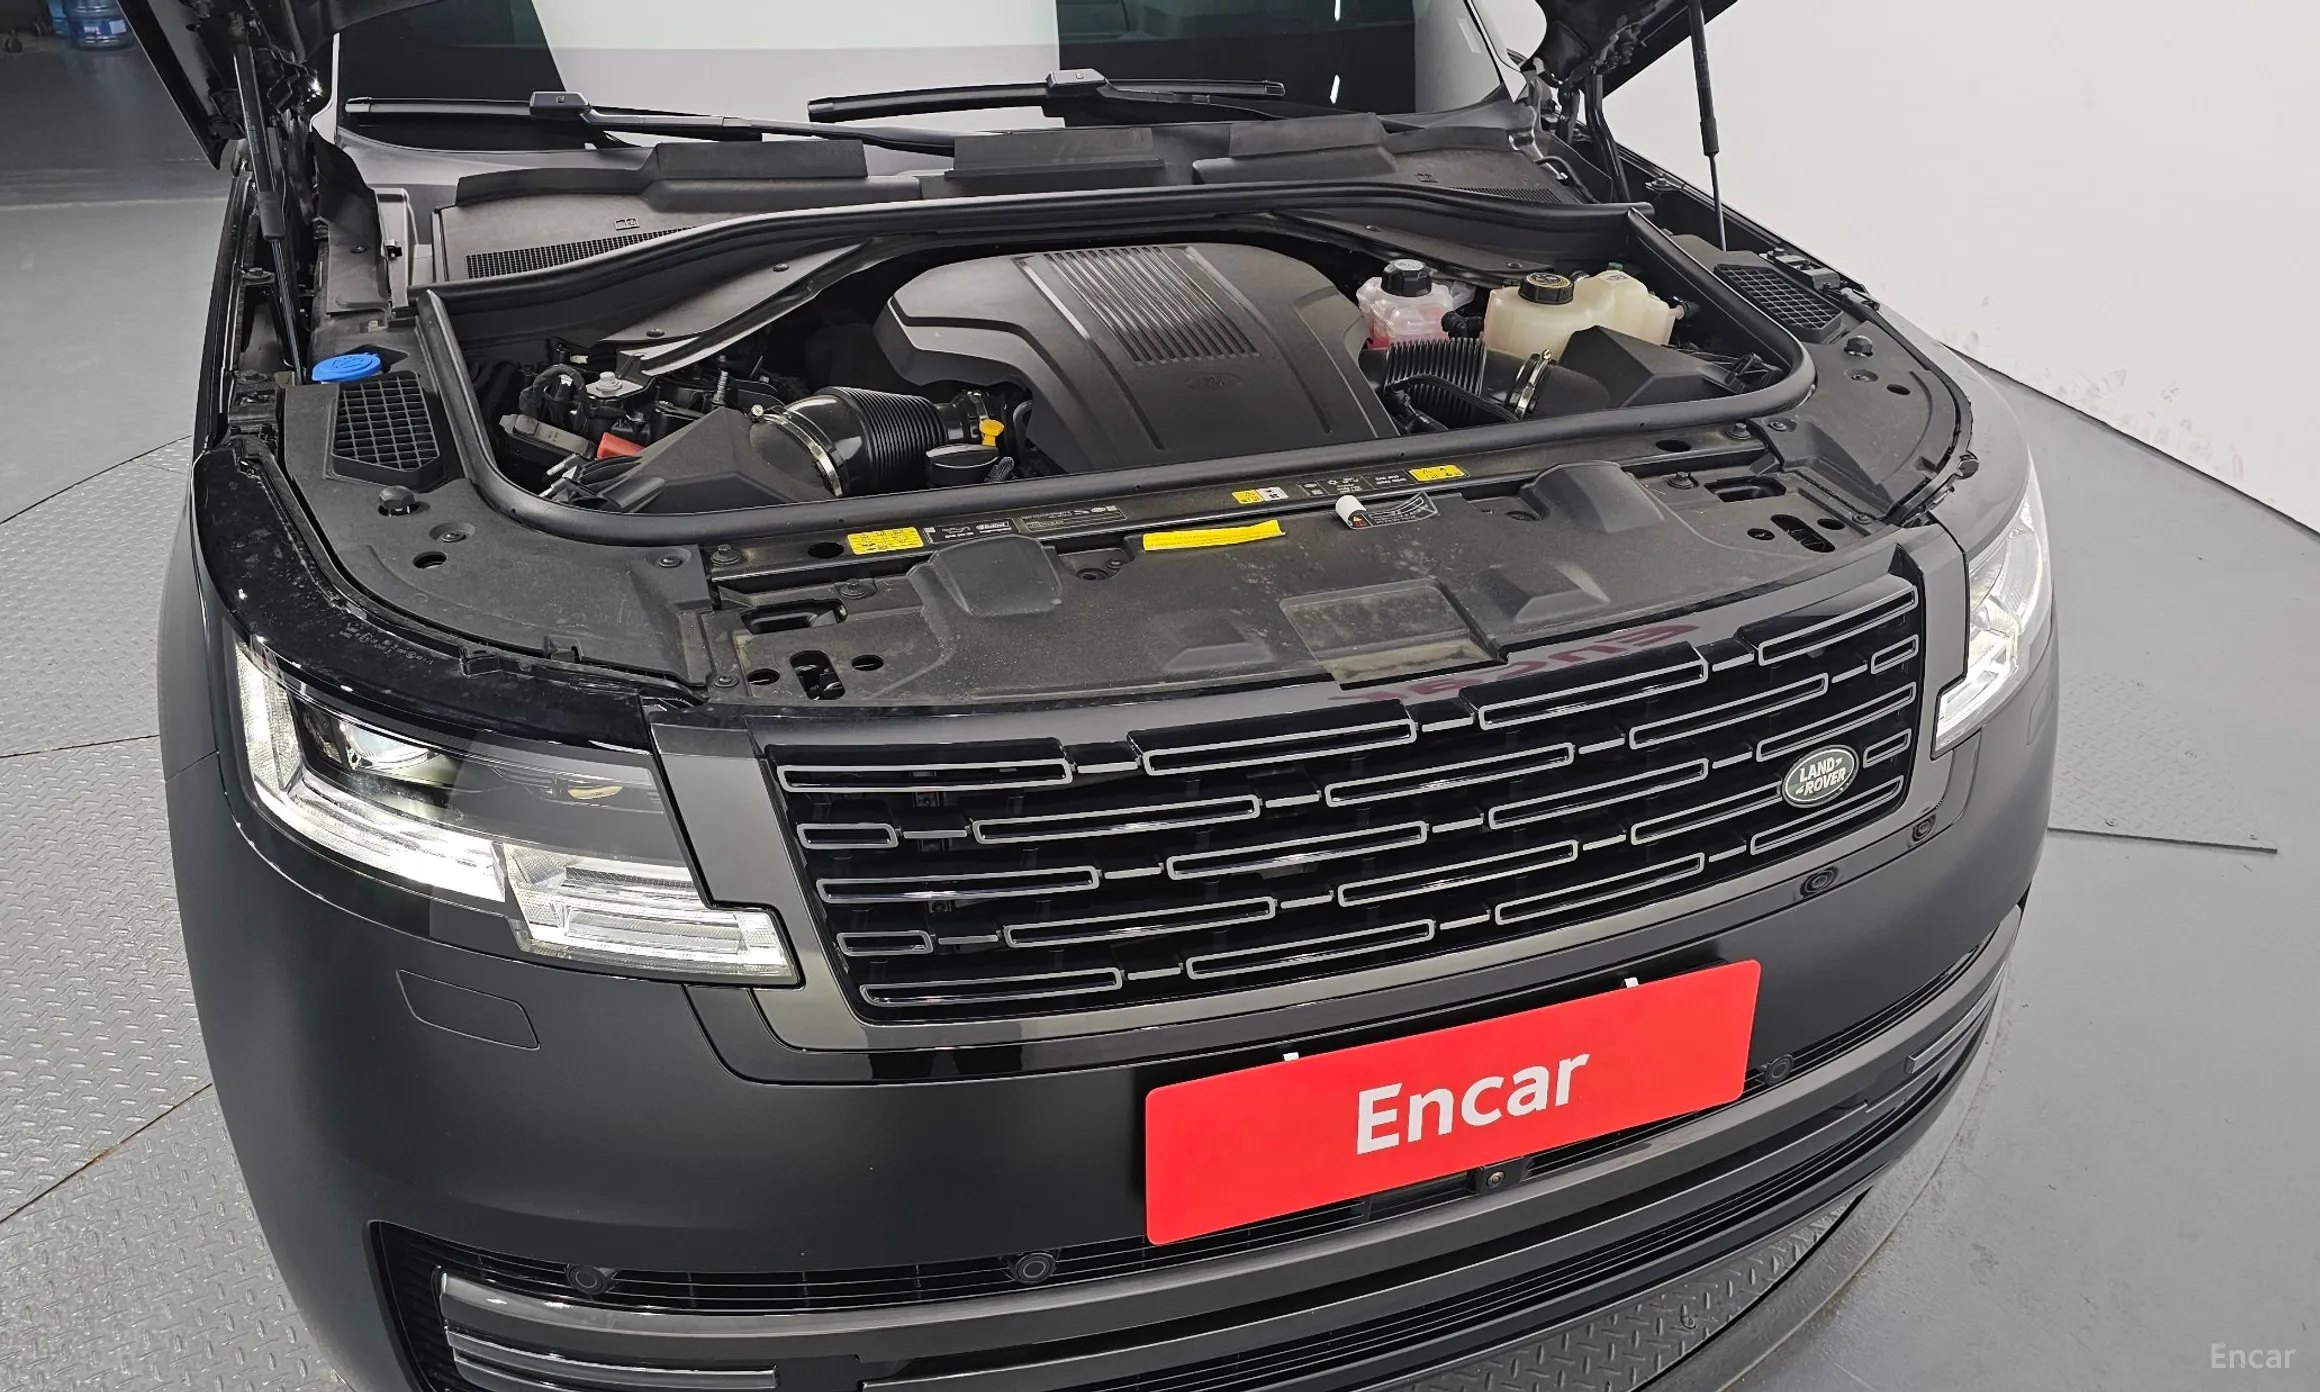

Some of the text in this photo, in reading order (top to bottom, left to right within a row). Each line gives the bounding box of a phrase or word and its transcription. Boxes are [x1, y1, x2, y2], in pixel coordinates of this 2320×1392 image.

[1800, 757, 1835, 782] LAND
[1803, 767, 1846, 796] ROVER
[1356, 1053, 1591, 1155] Encar
